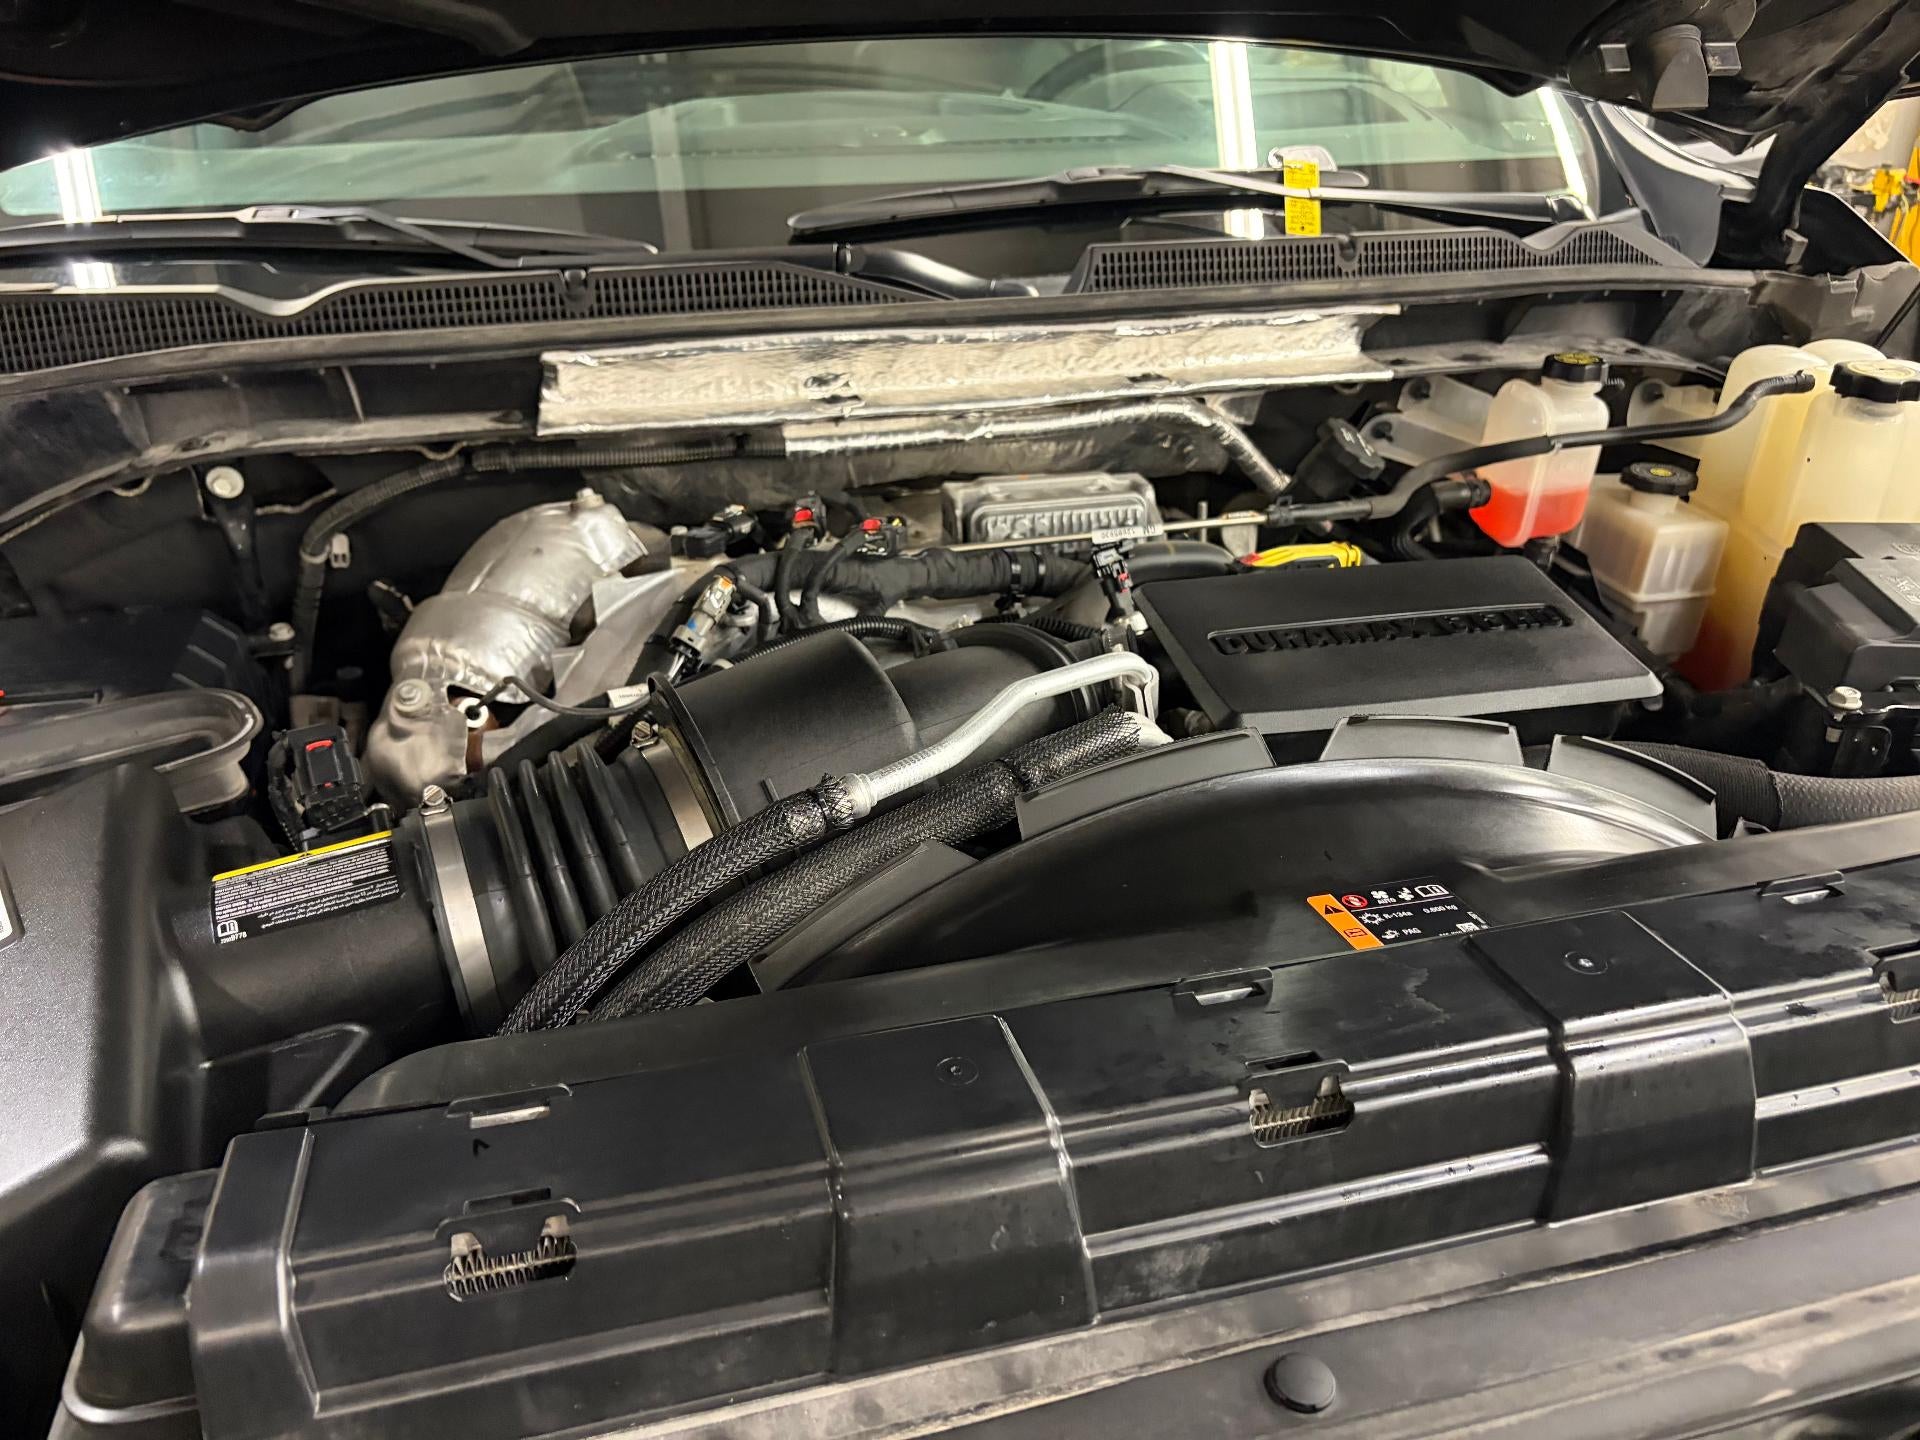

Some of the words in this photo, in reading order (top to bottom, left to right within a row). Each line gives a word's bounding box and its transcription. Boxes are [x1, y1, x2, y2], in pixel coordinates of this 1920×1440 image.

[1211, 616, 1427, 654] DURAMAX
[1377, 897, 1397, 905] AUTO
[1402, 928, 1422, 936] PAG
